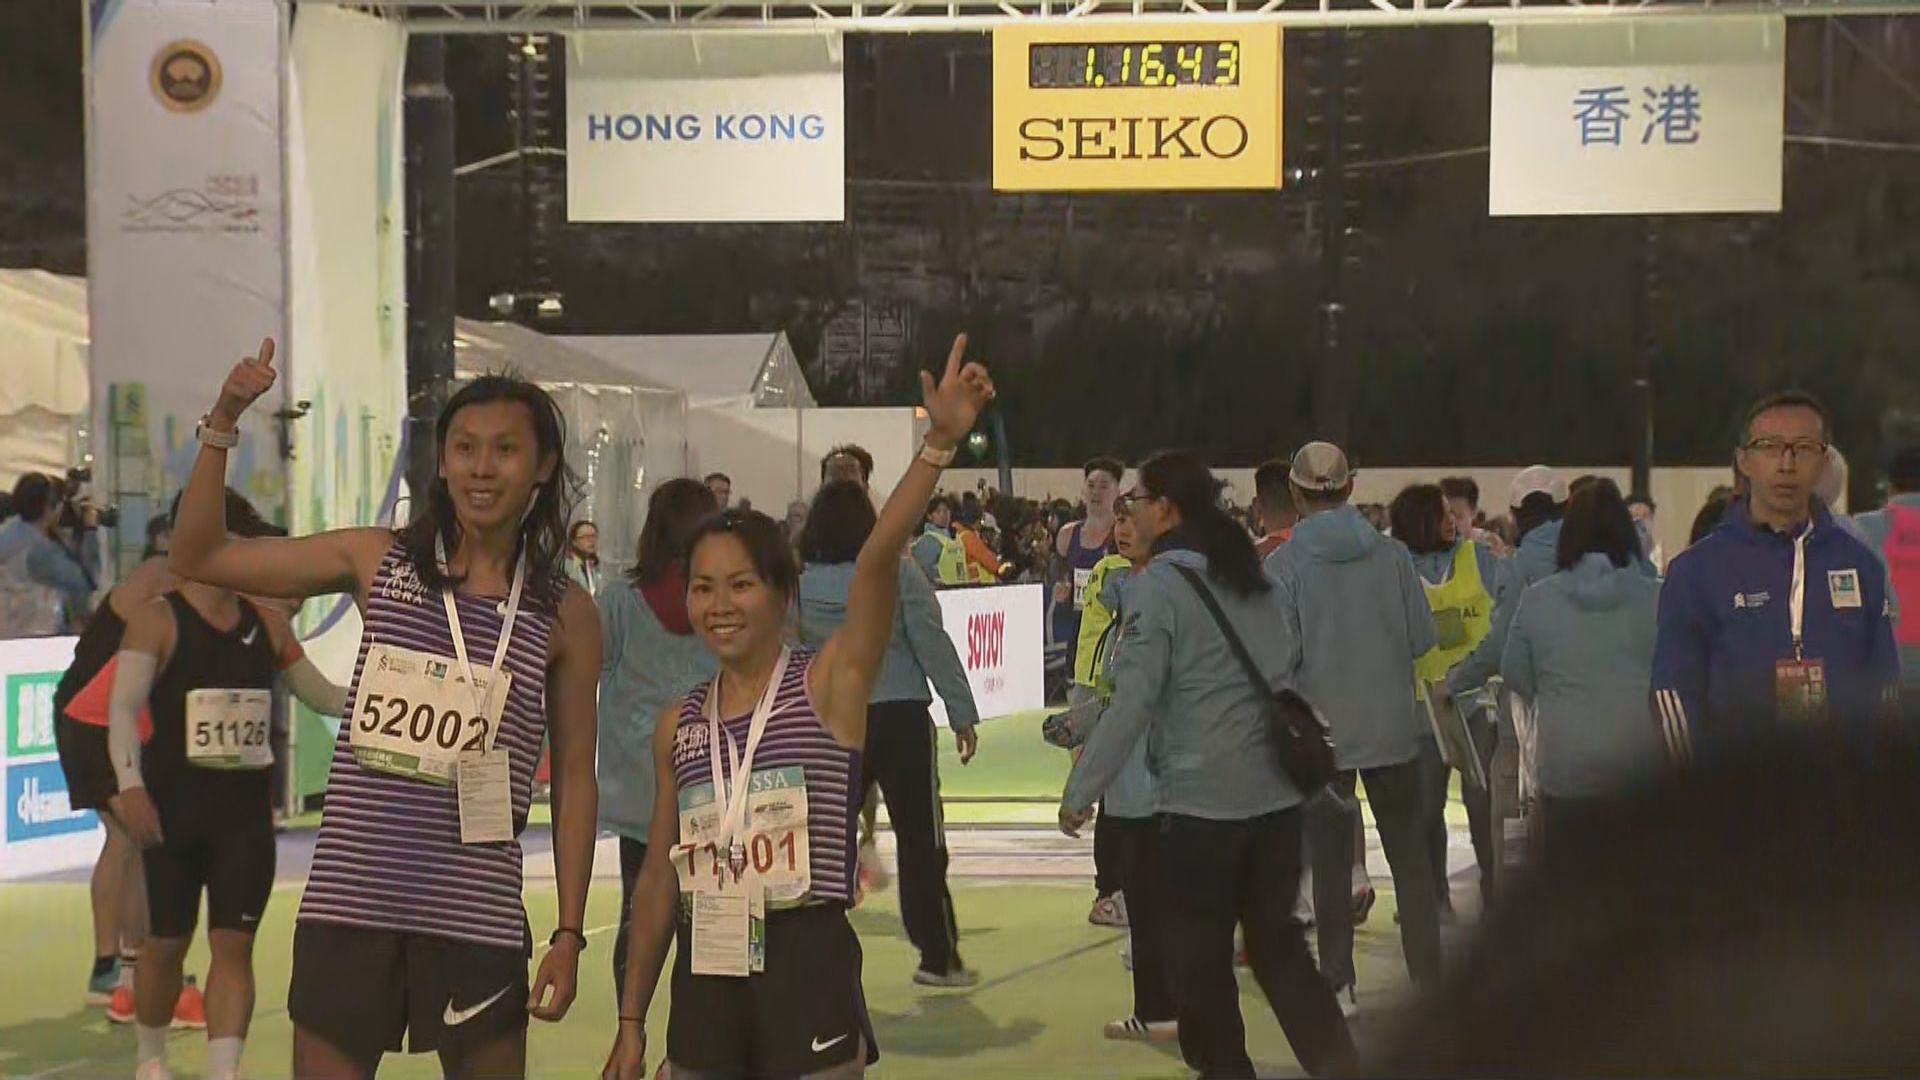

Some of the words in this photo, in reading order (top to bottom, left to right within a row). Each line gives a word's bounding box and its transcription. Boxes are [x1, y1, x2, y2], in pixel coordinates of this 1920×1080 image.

[588, 114, 700, 141] HONG
[715, 114, 825, 140] KONG
[1019, 115, 1248, 160] SEIKO
[1573, 84, 1702, 146] 香港
[967, 611, 1005, 671] SOYJOY
[195, 721, 266, 748] 51126
[359, 694, 489, 752] 52002
